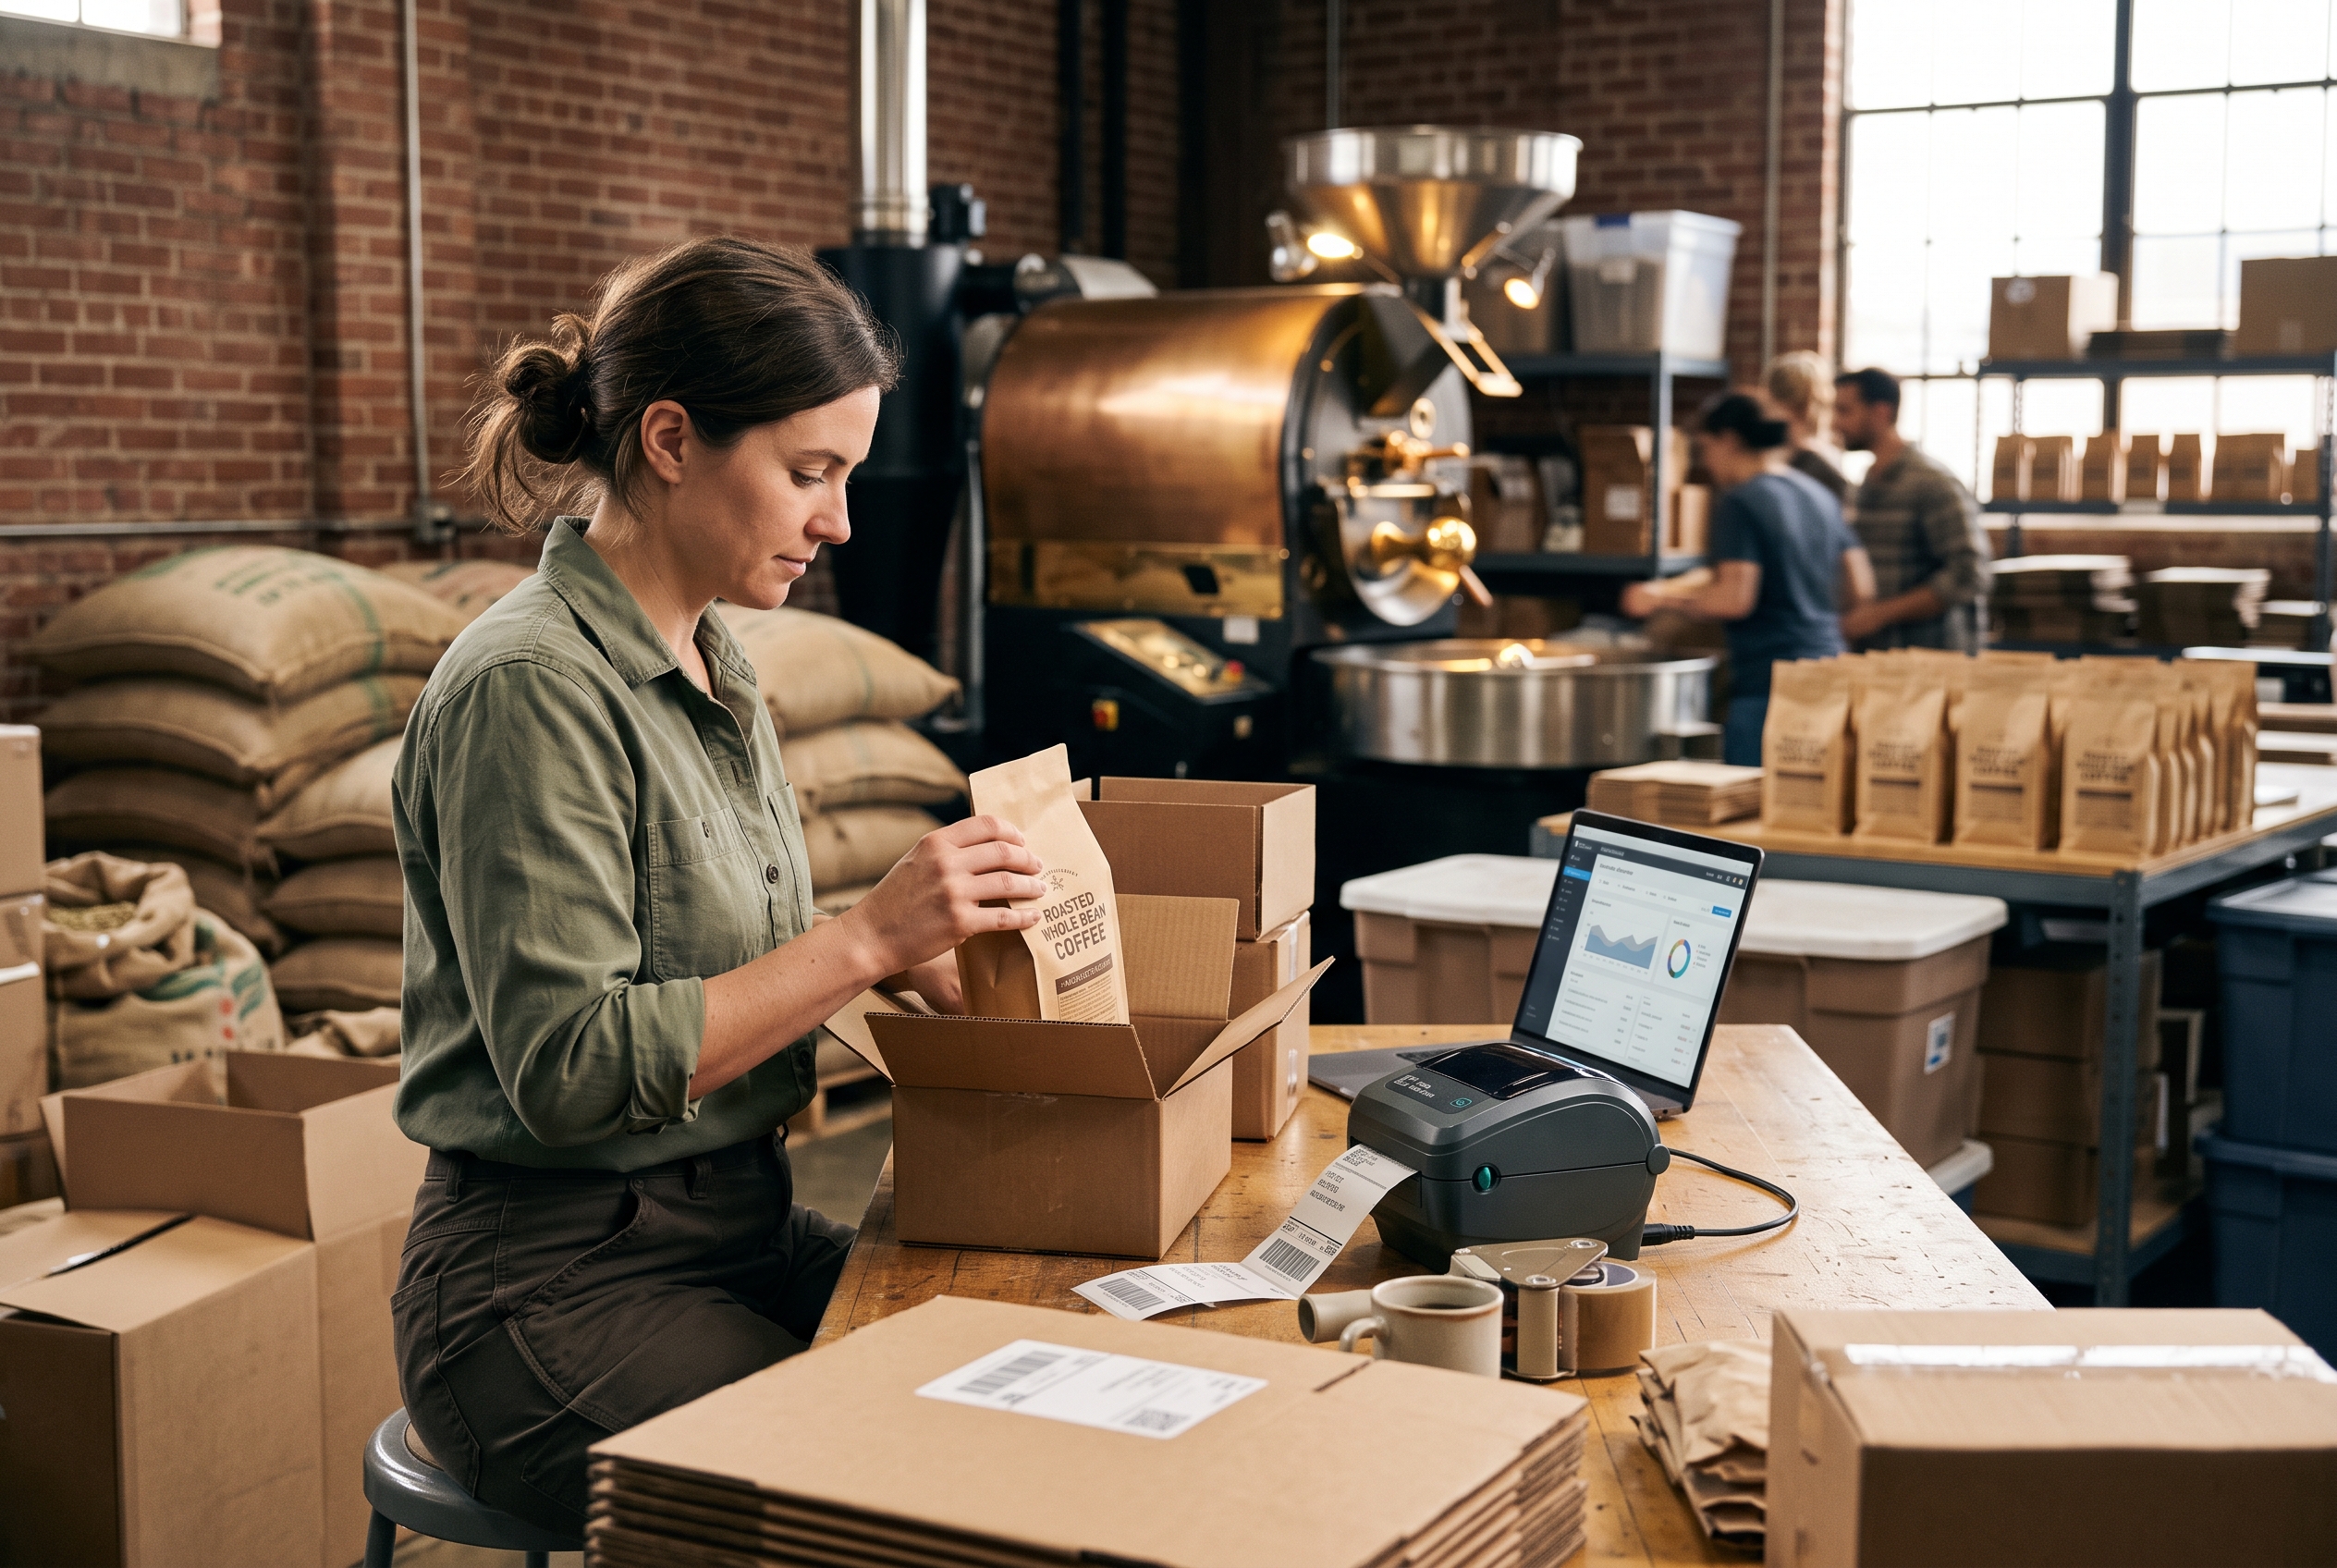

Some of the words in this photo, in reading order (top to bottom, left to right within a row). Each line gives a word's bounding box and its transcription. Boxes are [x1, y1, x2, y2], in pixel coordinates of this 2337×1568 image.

[1041, 916, 1079, 941] WHOLE
[1079, 903, 1107, 926] BEAN
[1043, 891, 1095, 923] ROASTED
[1054, 922, 1107, 961] COFFEE
